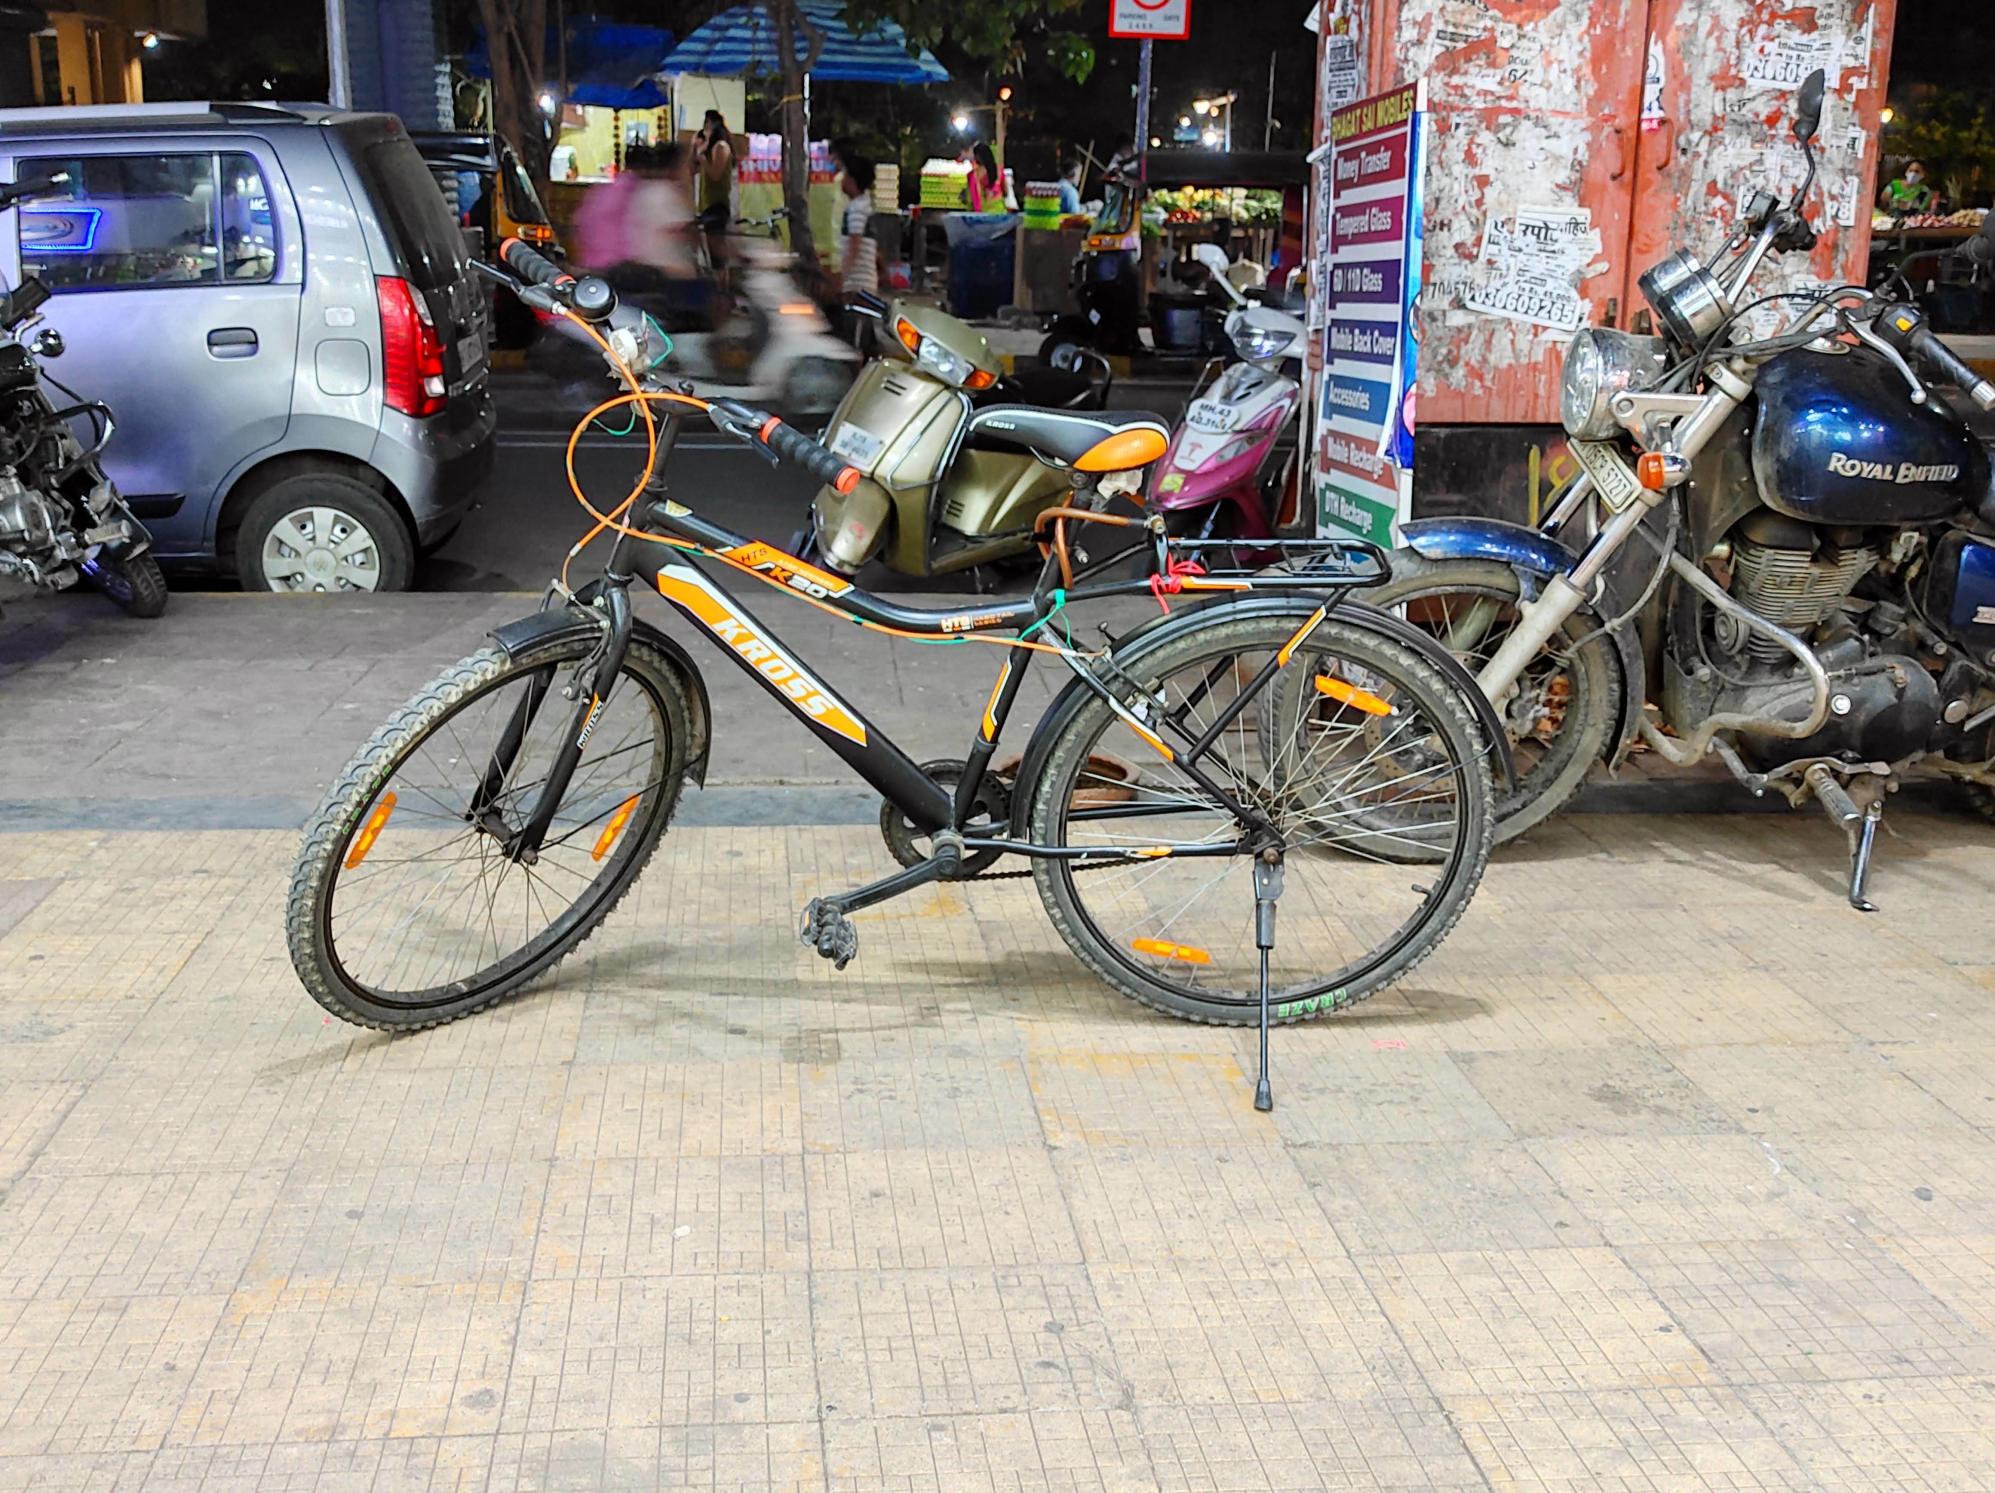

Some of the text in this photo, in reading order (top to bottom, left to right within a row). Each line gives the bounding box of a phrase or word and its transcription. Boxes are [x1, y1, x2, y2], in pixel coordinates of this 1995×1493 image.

[1376, 88, 1414, 128] MOBILES
[1337, 146, 1392, 182] Money Transfer
[1335, 206, 1392, 240] Tempered Glass
[1363, 268, 1383, 293] Glass
[1331, 326, 1396, 356] Mobile Back Cover
[1328, 380, 1370, 411] Accessories
[1327, 437, 1384, 481] Mobile Recharge
[1827, 452, 1960, 485] ROYAL ENFIELD
[1602, 466, 1627, 498] 5727
[1324, 490, 1373, 534] DTH Recharge
[740, 546, 768, 564] HTS
[711, 616, 835, 716] KROSS
[1277, 987, 1348, 1018] CRAZE
